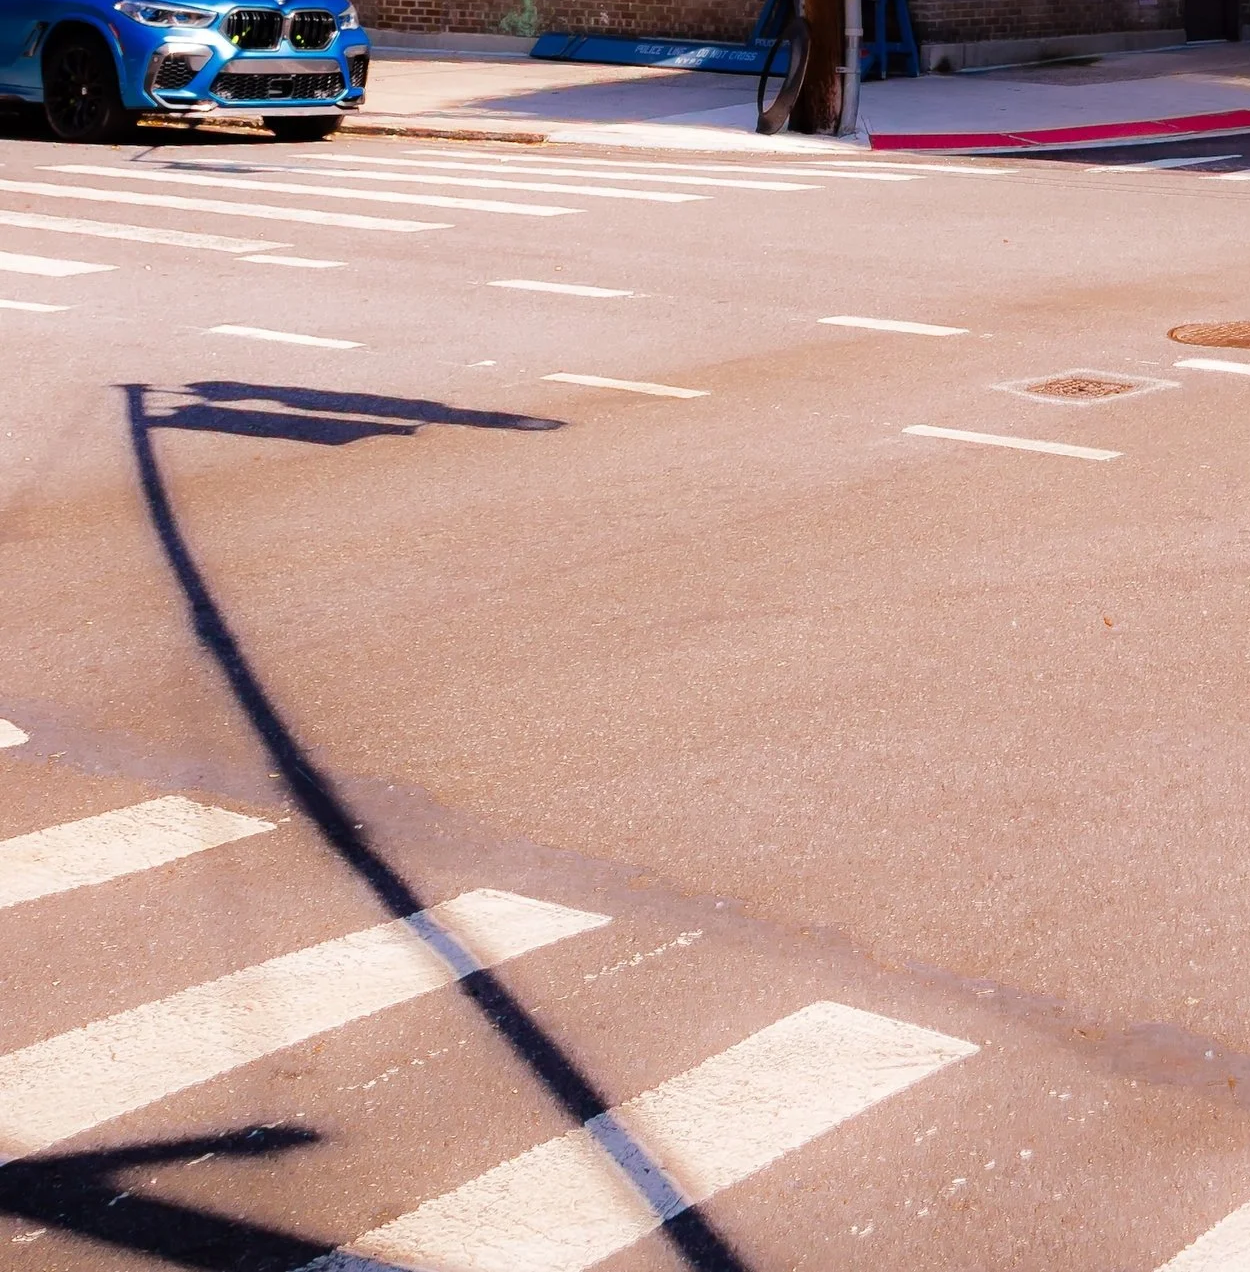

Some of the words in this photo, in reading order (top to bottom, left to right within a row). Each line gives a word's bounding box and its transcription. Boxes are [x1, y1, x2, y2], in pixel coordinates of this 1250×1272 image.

[634, 44, 664, 55] POLICE
[666, 46, 687, 56] LINE
[695, 48, 708, 58] DO
[709, 49, 728, 59] NOT
[728, 51, 758, 61] CROSS
[674, 57, 703, 66] NYPD
